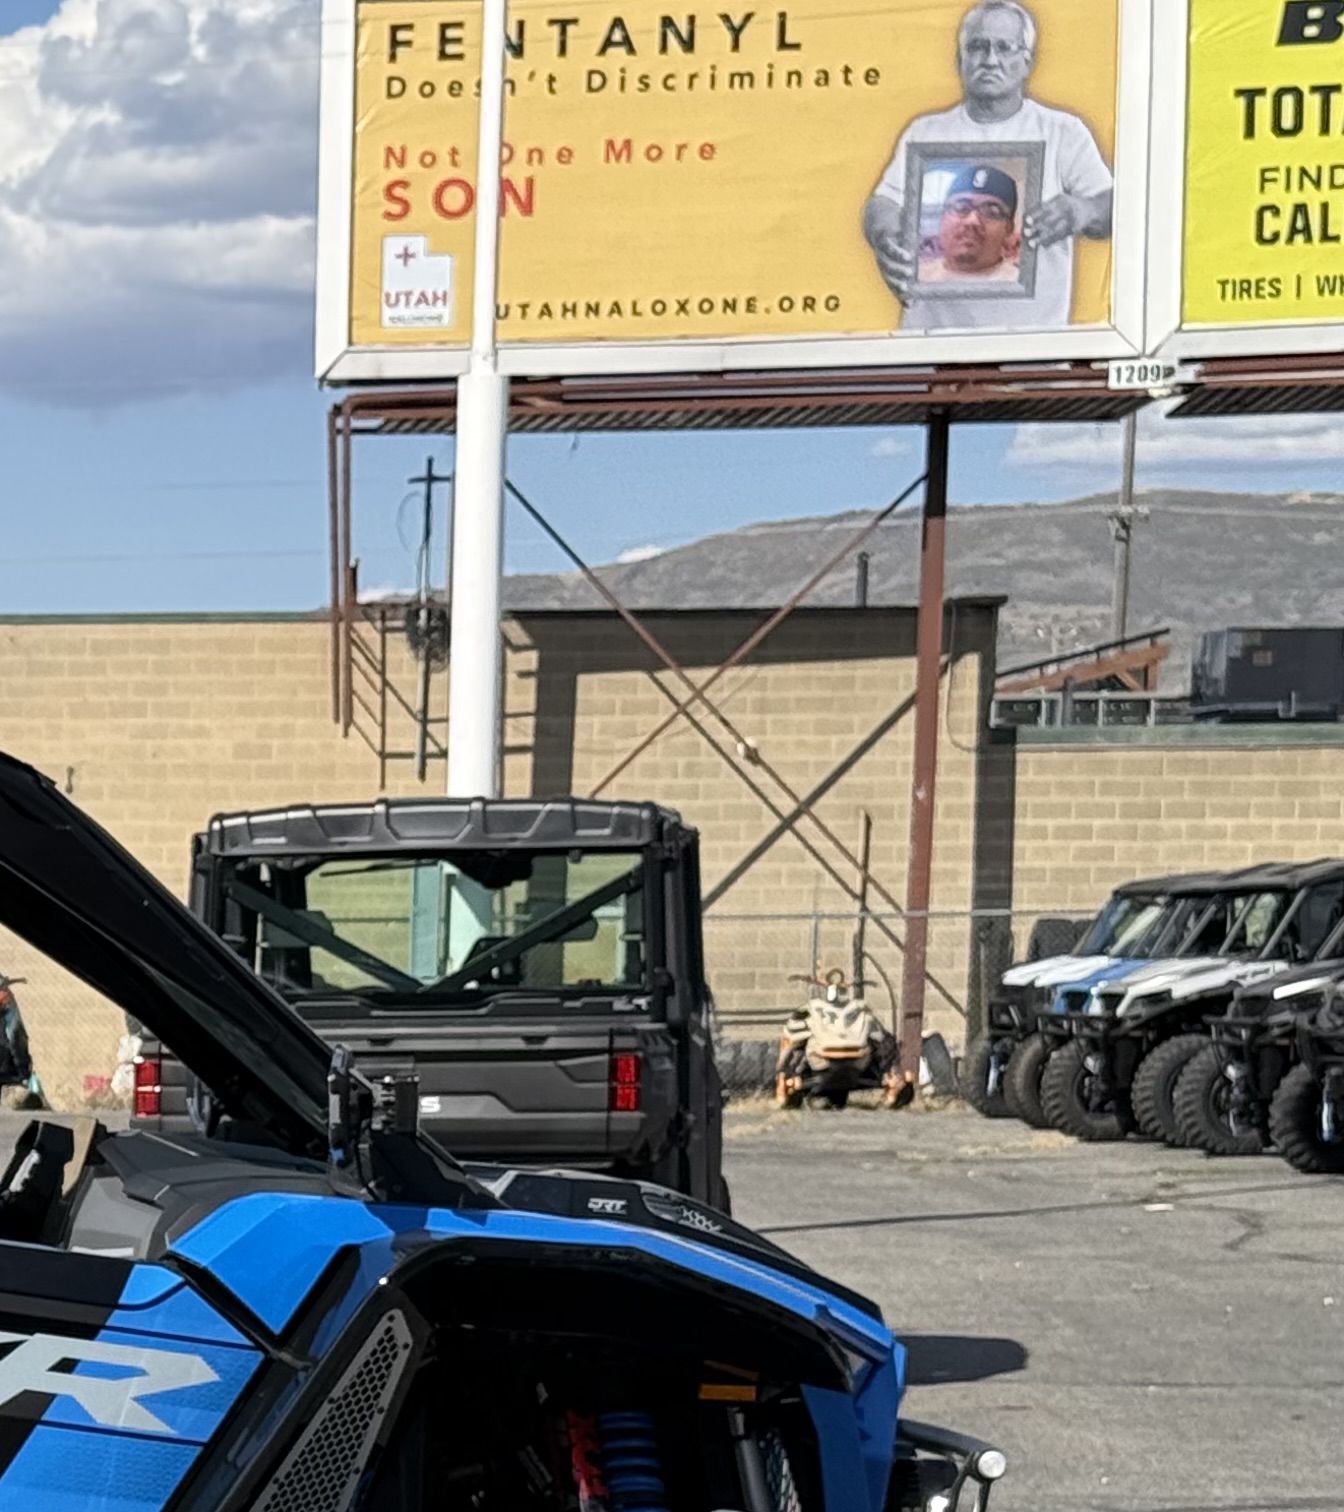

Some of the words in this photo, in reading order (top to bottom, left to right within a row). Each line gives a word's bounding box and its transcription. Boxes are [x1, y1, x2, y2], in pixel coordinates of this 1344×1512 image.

[388, 11, 802, 64] FENTANYL
[585, 62, 881, 94] Discriminate
[1233, 83, 1344, 140] TOT
[383, 144, 461, 169] Not
[603, 138, 718, 164] More
[382, 175, 535, 221] SON
[384, 290, 448, 309] UTAH
[1216, 277, 1282, 302] TIRES
[495, 294, 842, 321] UTAHNALOXONE.ORG
